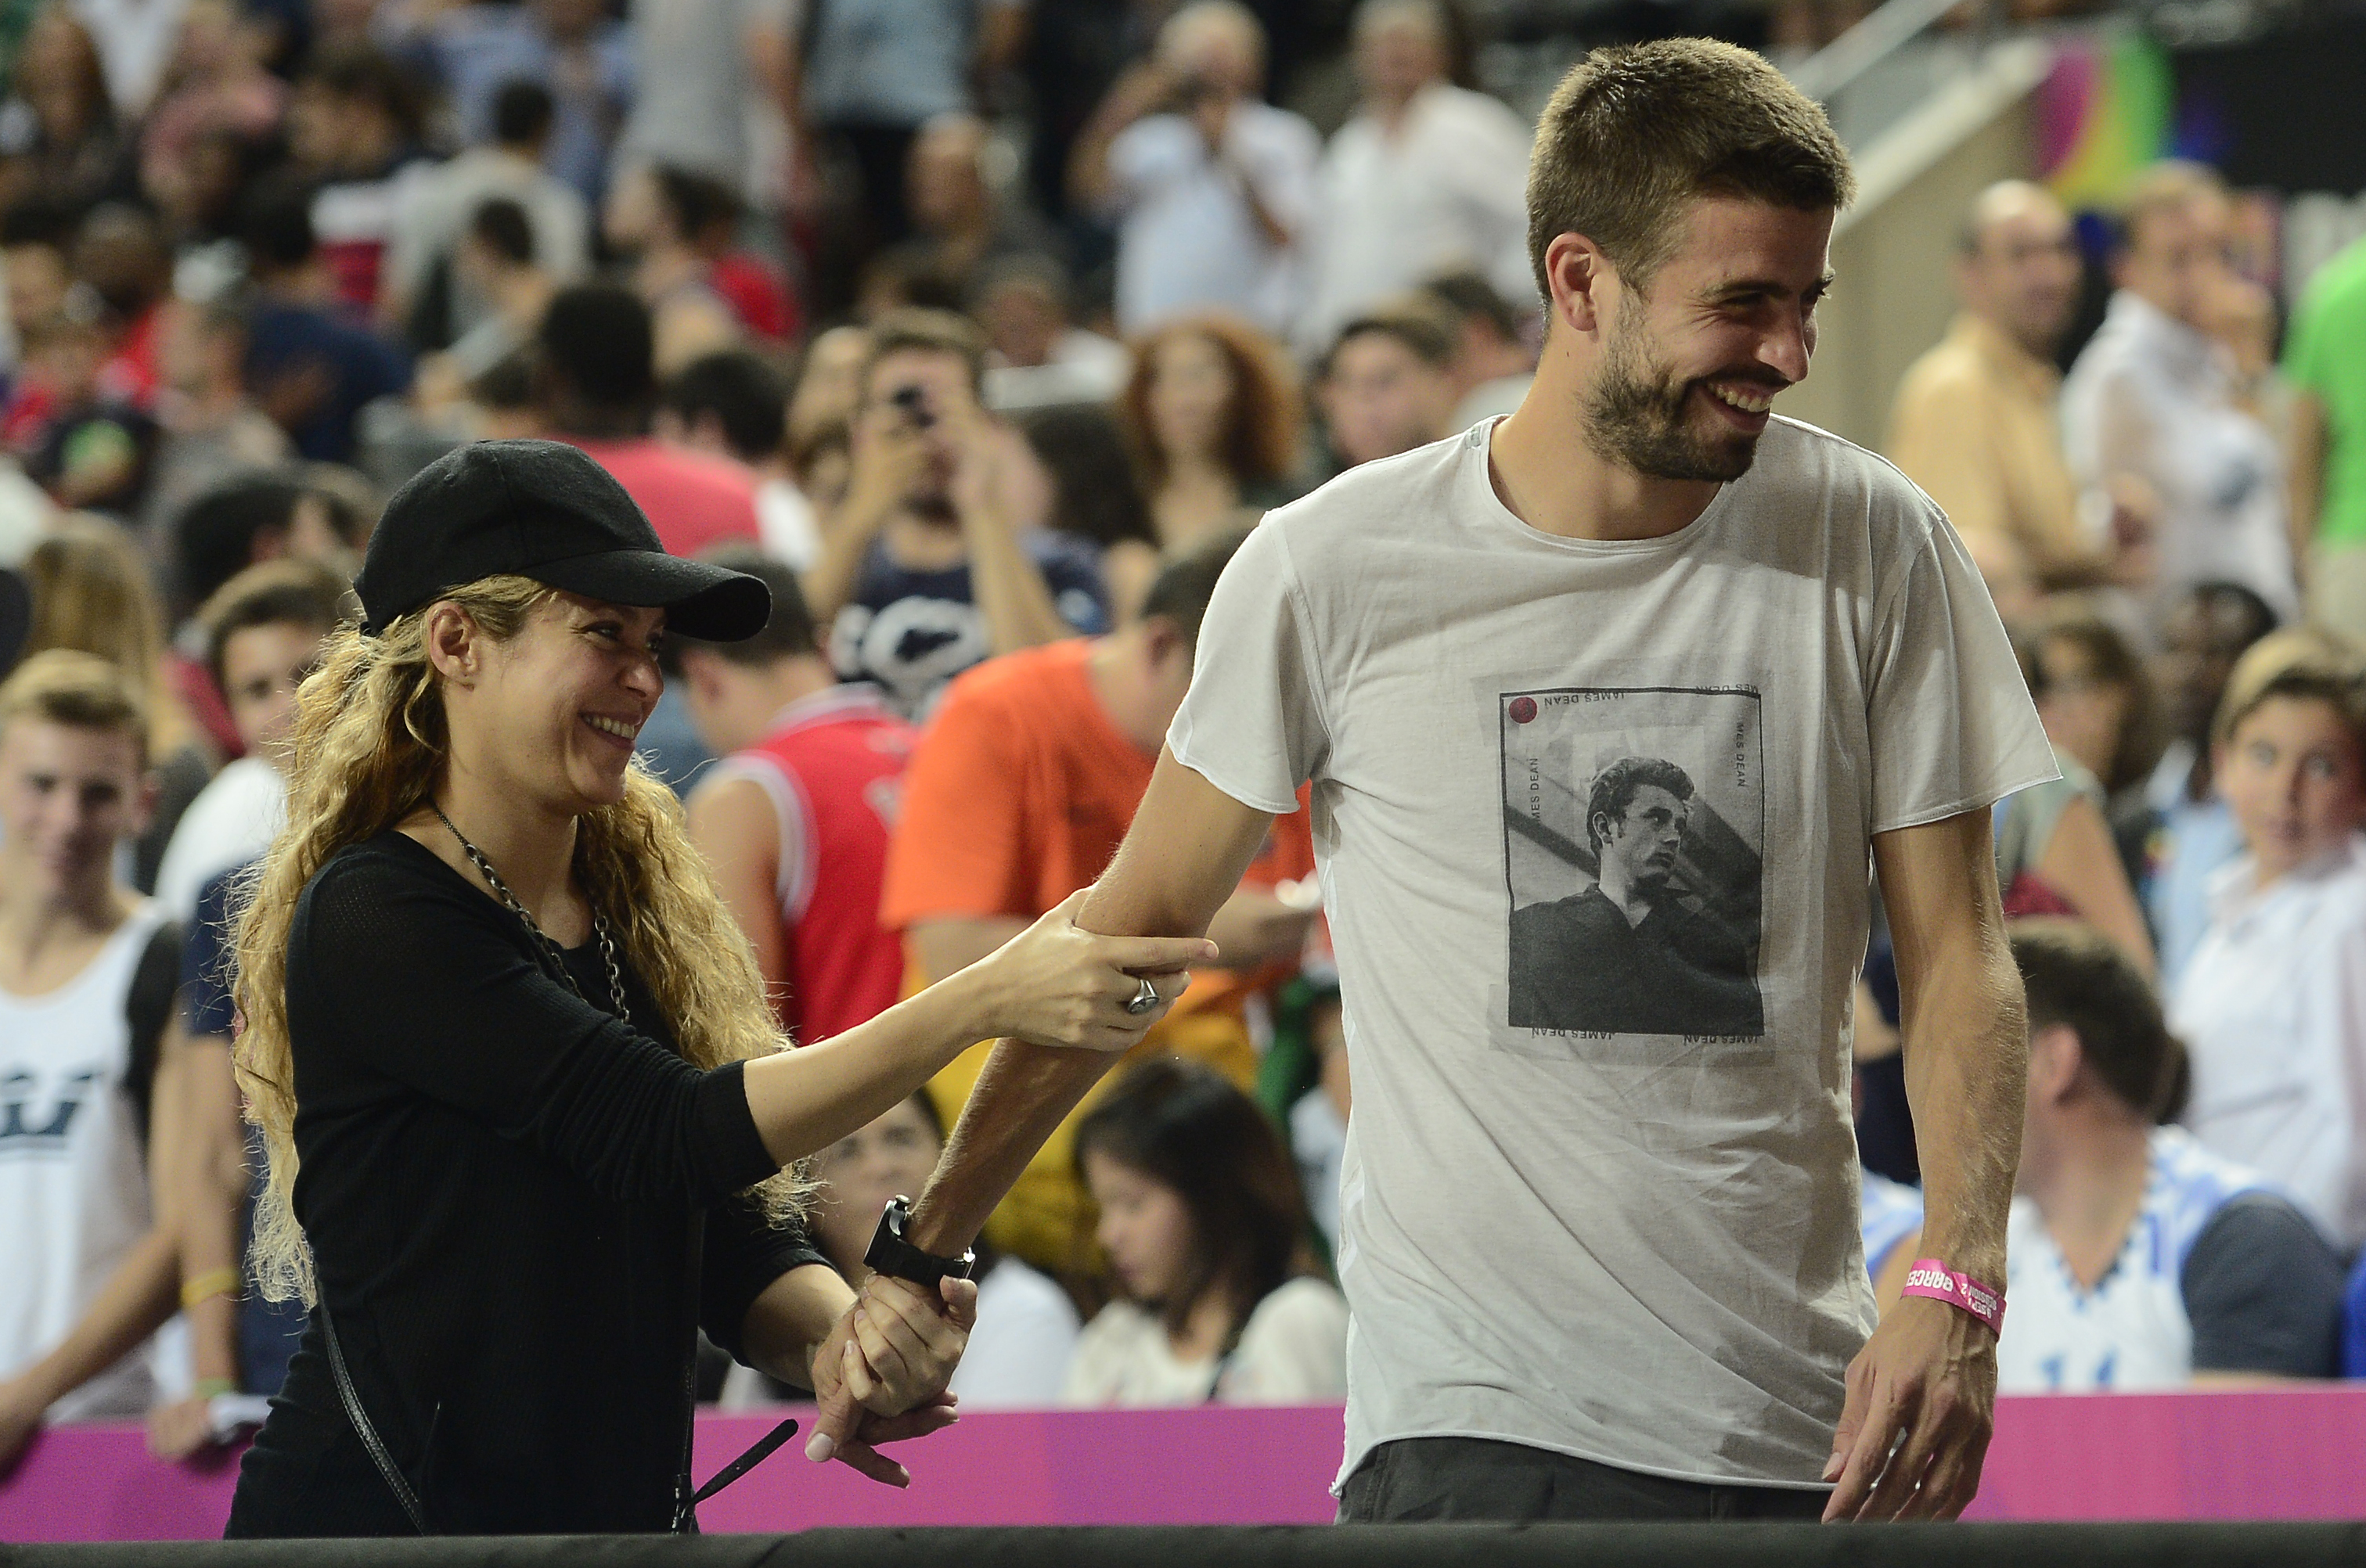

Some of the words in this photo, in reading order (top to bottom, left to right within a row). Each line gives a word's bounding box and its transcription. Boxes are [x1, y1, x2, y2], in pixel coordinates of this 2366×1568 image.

[1543, 693, 1579, 707] DEAN
[1529, 757, 1540, 791] DEAN
[1735, 753, 1745, 788] DEAN
[1531, 1027, 1566, 1039] DEAN
[1961, 1283, 1968, 1295] 2
[1972, 1301, 1986, 1315] SEP
